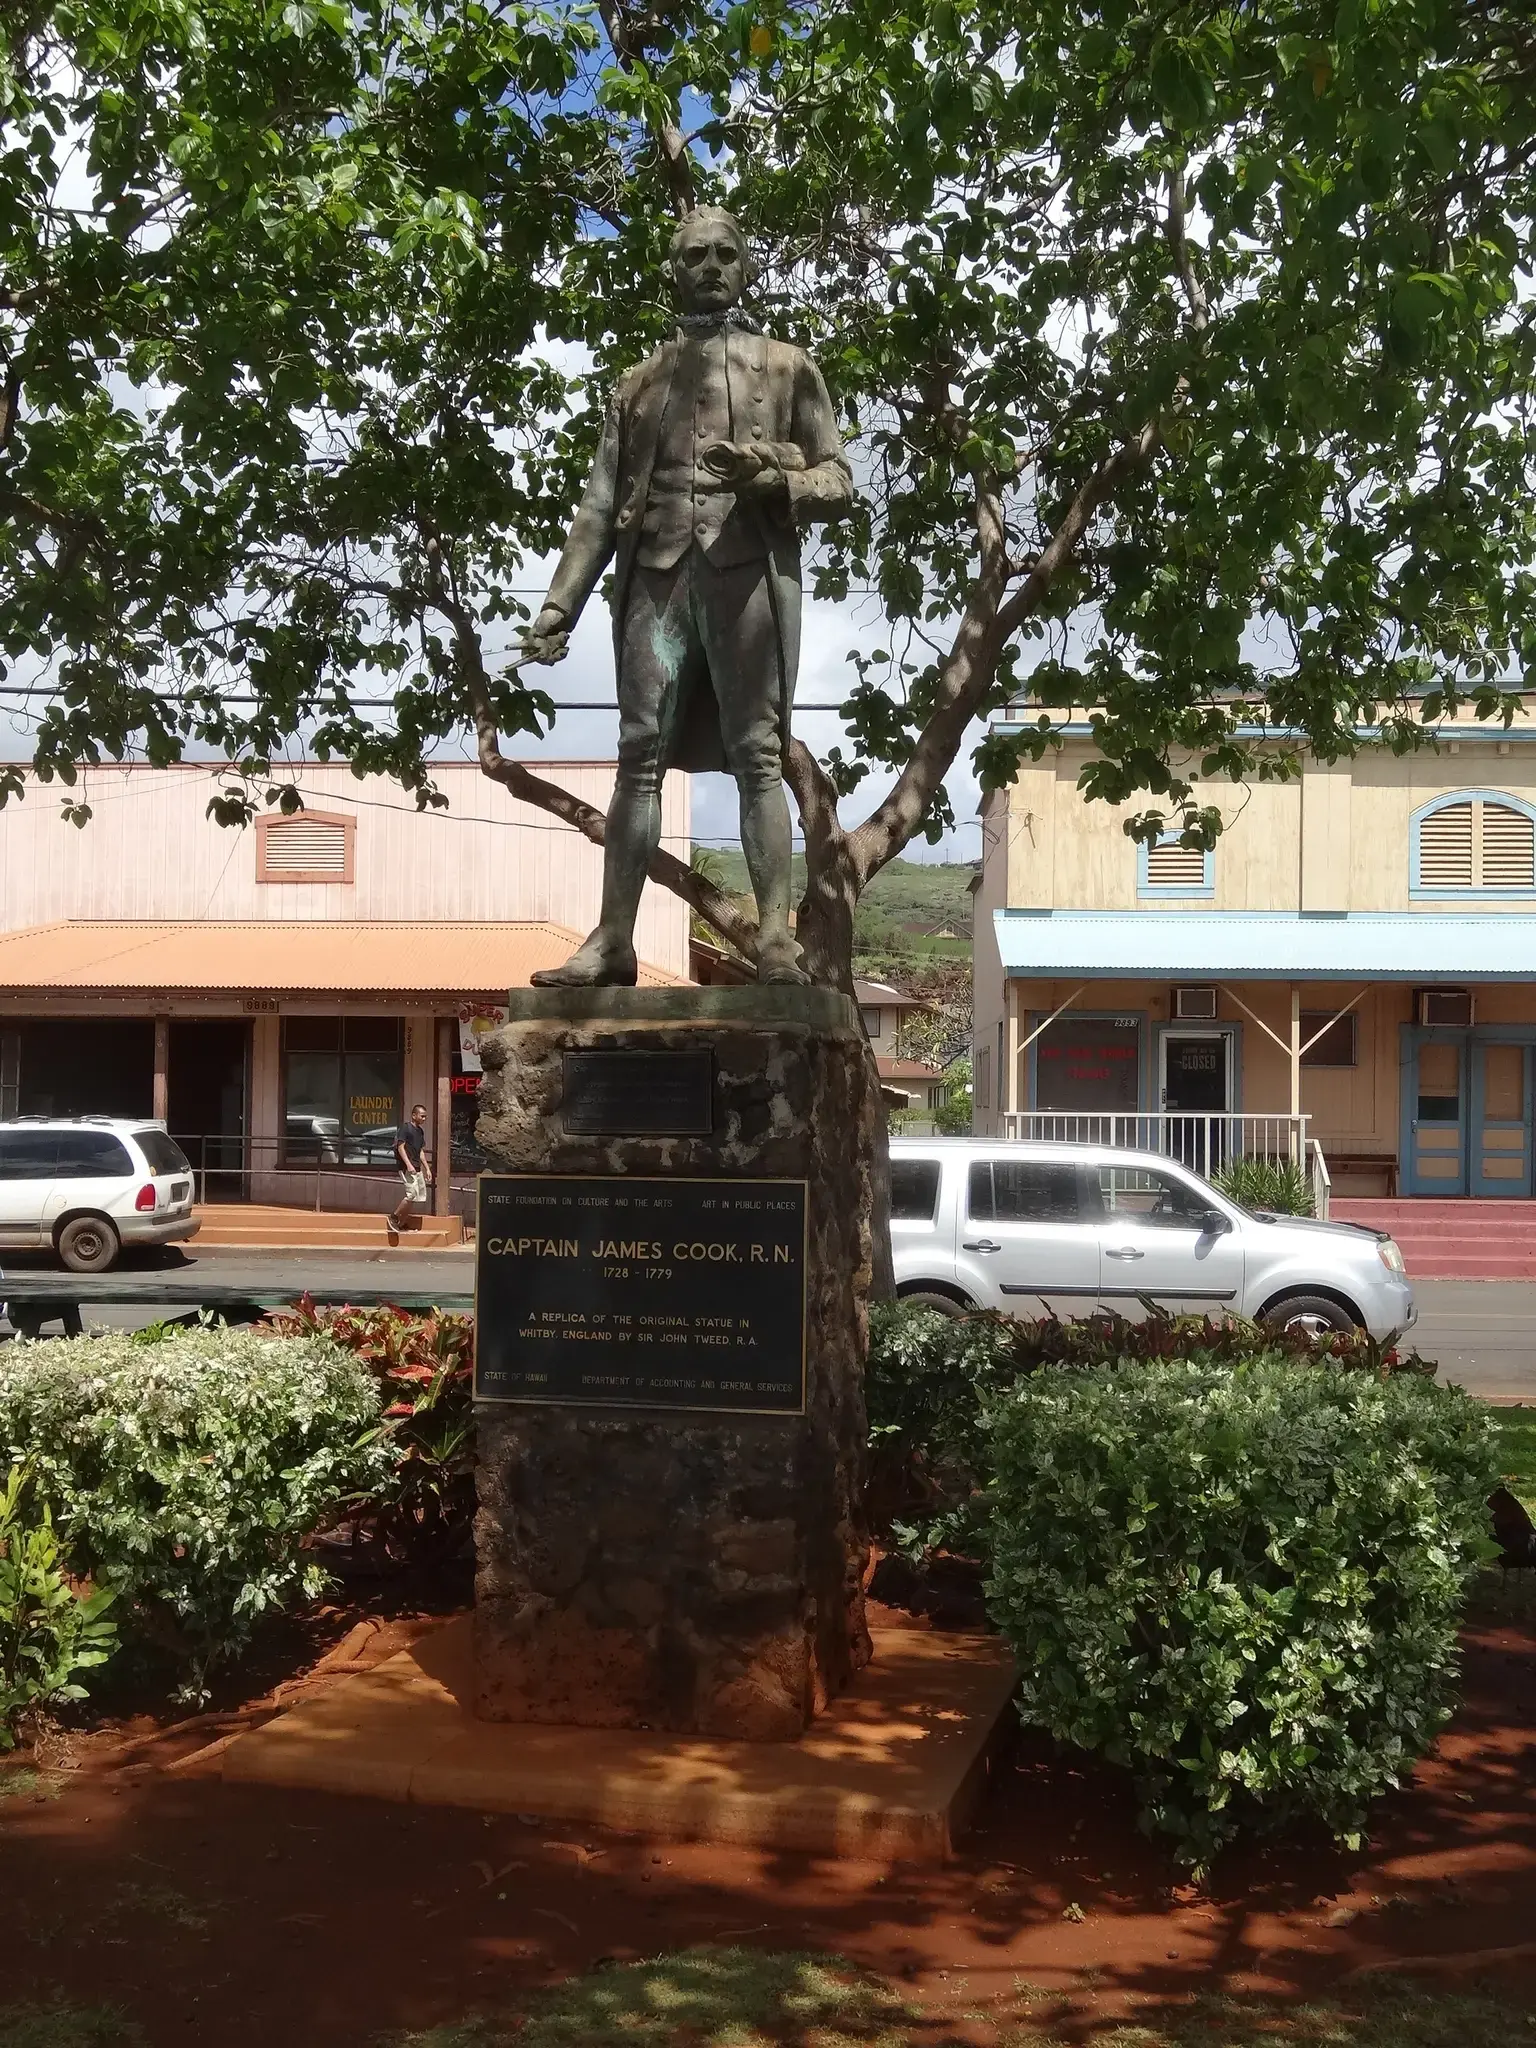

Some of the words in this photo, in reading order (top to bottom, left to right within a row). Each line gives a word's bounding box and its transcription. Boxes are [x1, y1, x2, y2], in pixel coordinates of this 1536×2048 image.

[1181, 1055, 1216, 1071] CLOSED
[349, 1096, 394, 1111] LAUNDRY
[352, 1111, 388, 1126] CENTER
[487, 1195, 511, 1205] STATE
[515, 1196, 557, 1206] FOUNDATION
[561, 1197, 572, 1206] ON
[577, 1197, 610, 1207] CULTURE
[614, 1198, 629, 1207] AND
[633, 1198, 649, 1208] THE
[653, 1199, 673, 1208] ARTS
[701, 1199, 717, 1209] ART
[721, 1200, 730, 1210] IN
[735, 1201, 762, 1211] PUBLIC
[766, 1201, 797, 1212] PLACES
[487, 1238, 579, 1257] CAPTAIN
[592, 1240, 662, 1260] JAMES
[673, 1243, 743, 1263] COOK,
[603, 1267, 629, 1279] 1728
[645, 1268, 673, 1280] 1779
[528, 1312, 537, 1321] A
[541, 1312, 586, 1323] REPLICA
[592, 1314, 606, 1324] OF
[613, 1315, 632, 1325] THE
[639, 1316, 690, 1327] ORIGINAL
[695, 1318, 733, 1328] STATUE
[739, 1319, 750, 1329] IN
[562, 1330, 612, 1341] ENGLAND
[618, 1332, 632, 1342] BY
[637, 1333, 654, 1343] SIR
[659, 1334, 688, 1344] JOHN
[484, 1371, 507, 1381] STATE
[511, 1372, 522, 1381] OF
[524, 1373, 549, 1383] HAWAII
[581, 1375, 630, 1386] DEPARTMENT
[635, 1377, 645, 1386] OF
[649, 1379, 697, 1389] ACCOUNTING
[700, 1380, 715, 1390] AND
[720, 1381, 753, 1392] GENERAL
[757, 1383, 793, 1393] SERVICES
